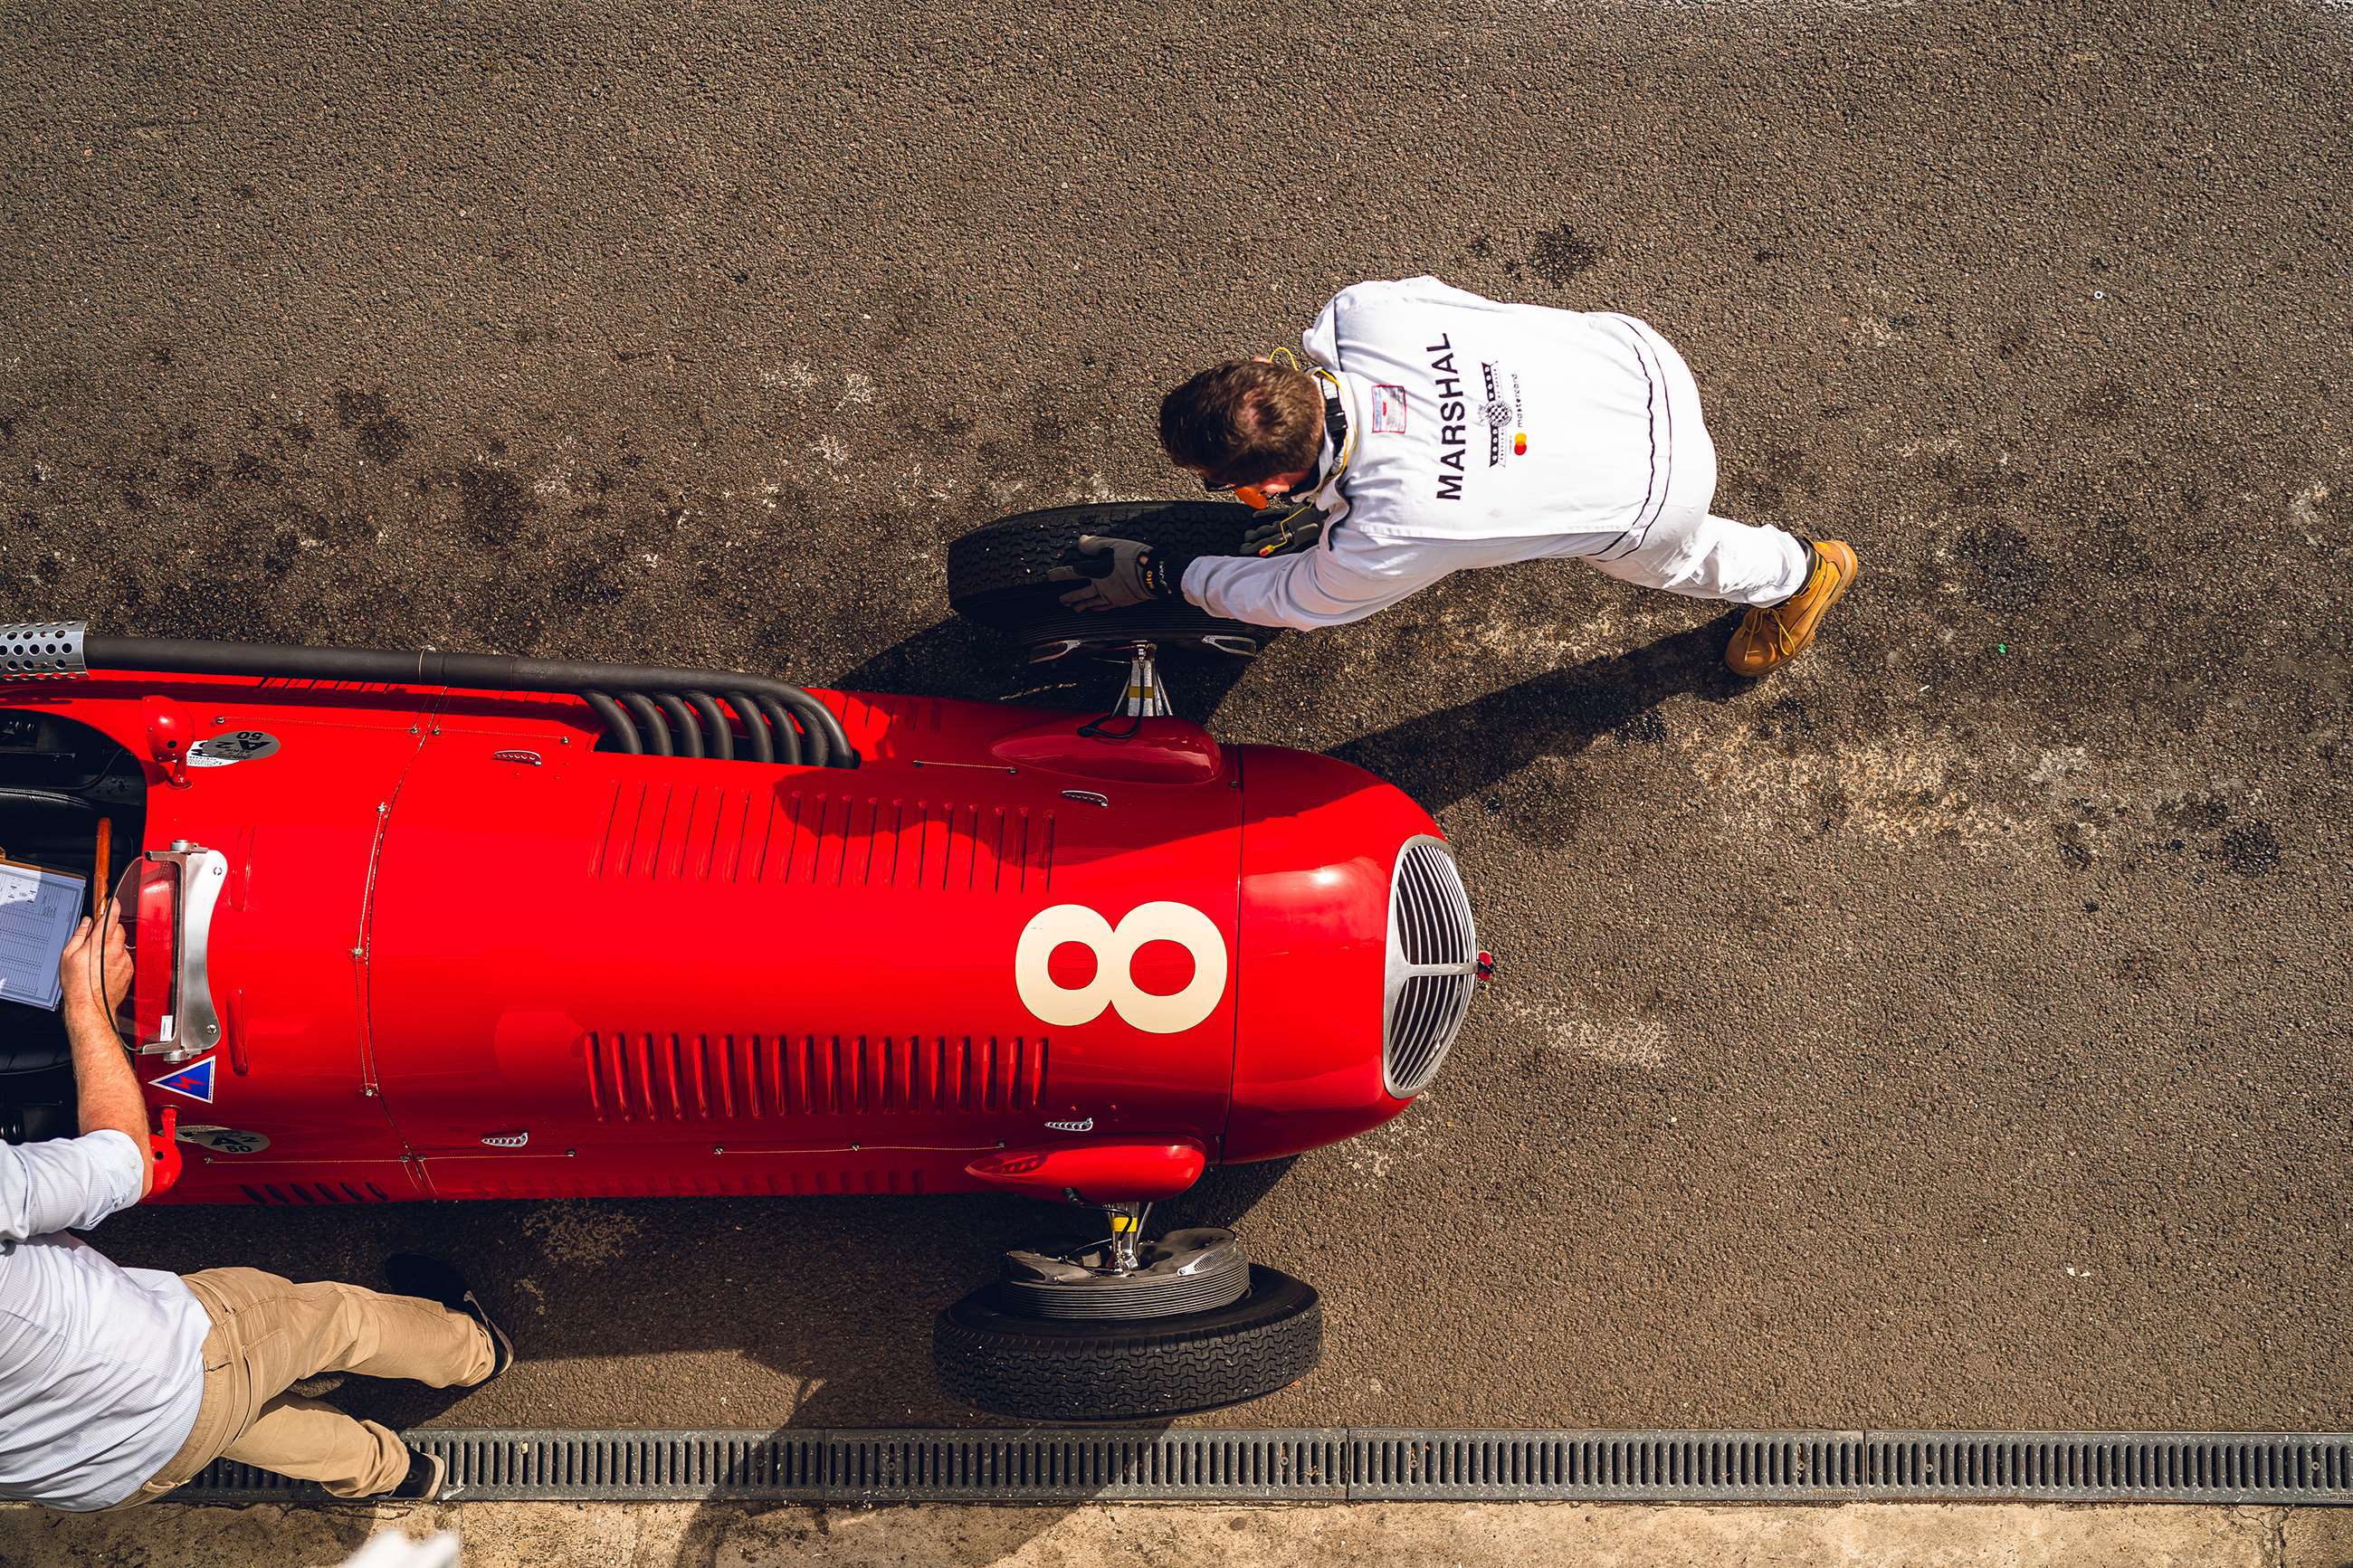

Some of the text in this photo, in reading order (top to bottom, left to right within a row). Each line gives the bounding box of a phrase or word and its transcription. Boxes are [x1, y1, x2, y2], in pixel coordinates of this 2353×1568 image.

[1426, 332, 1466, 500] MARSHAL
[1510, 373, 1523, 428] mastercard
[214, 740, 272, 751] A 2
[235, 732, 263, 741] 50
[1015, 901, 1228, 1033] 8
